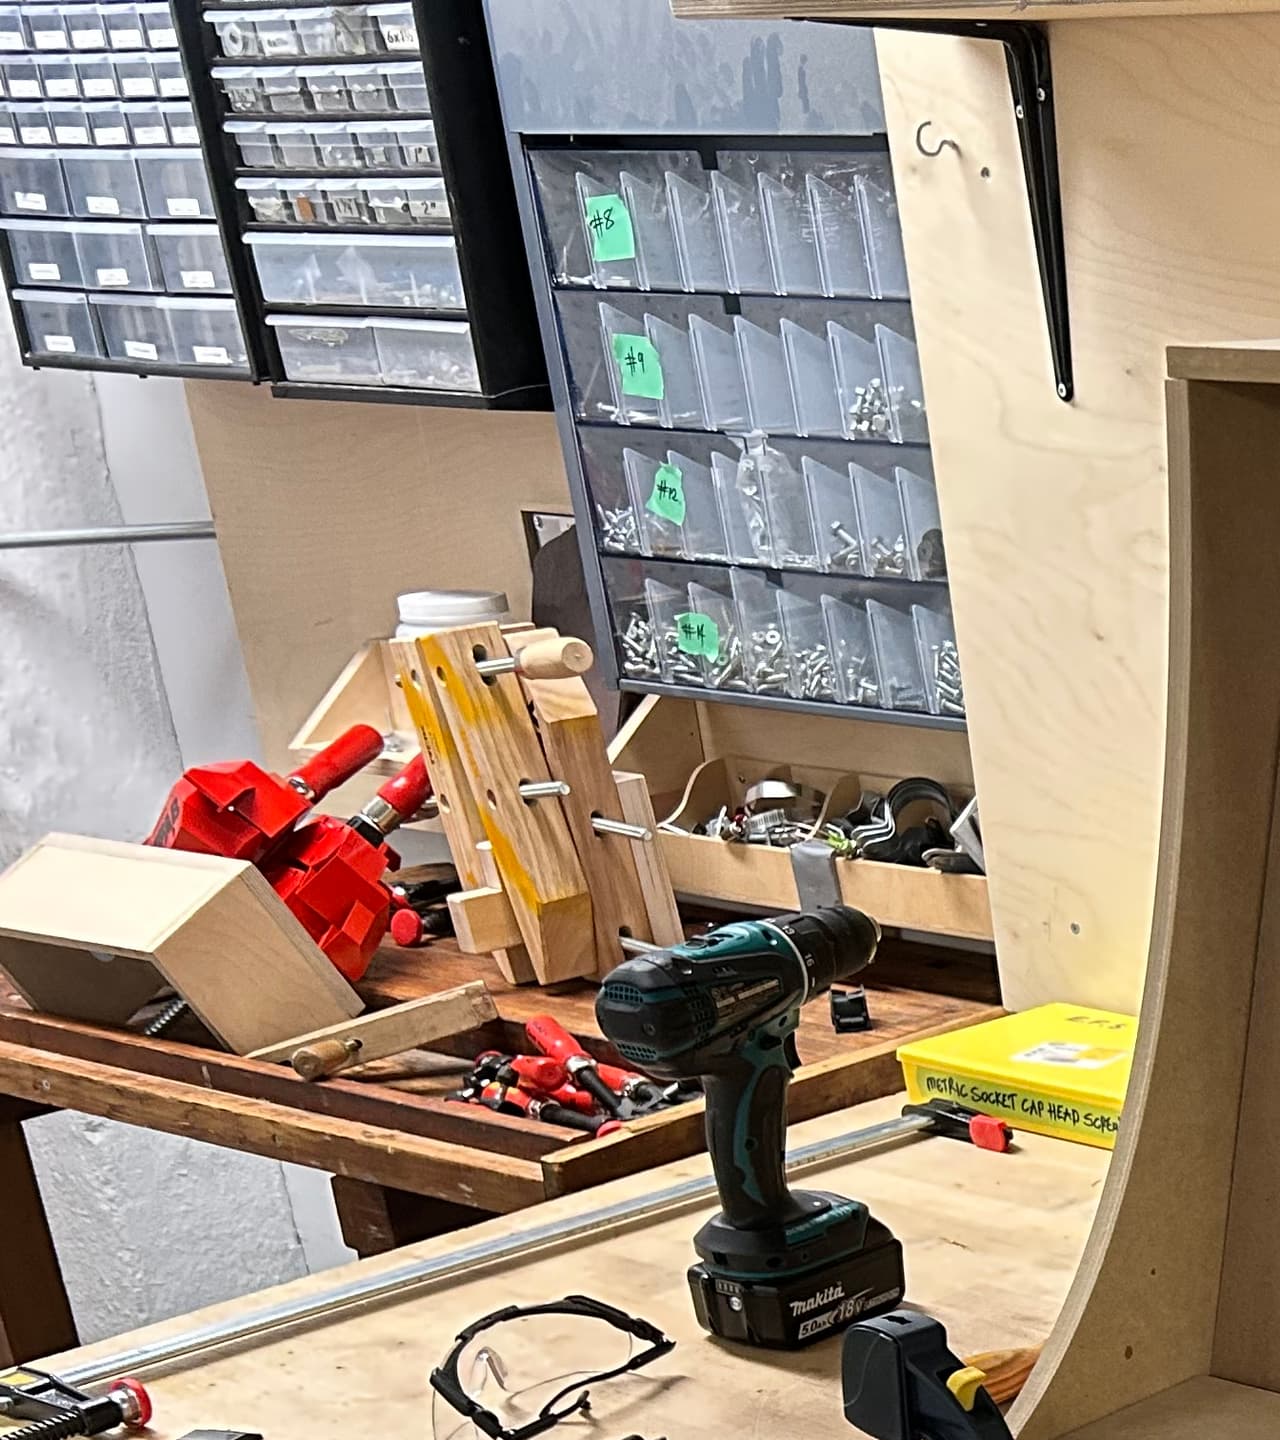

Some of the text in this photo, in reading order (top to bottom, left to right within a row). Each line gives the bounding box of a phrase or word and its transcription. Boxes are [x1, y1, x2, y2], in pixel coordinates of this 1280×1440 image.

[590, 206, 615, 240] #8
[625, 345, 645, 376] #9
[656, 480, 679, 502] #12
[926, 1077, 968, 1098] METRIC
[971, 1087, 1018, 1110] SOCKET
[1021, 1099, 1044, 1116] CAP
[1047, 1102, 1080, 1125] HEAD
